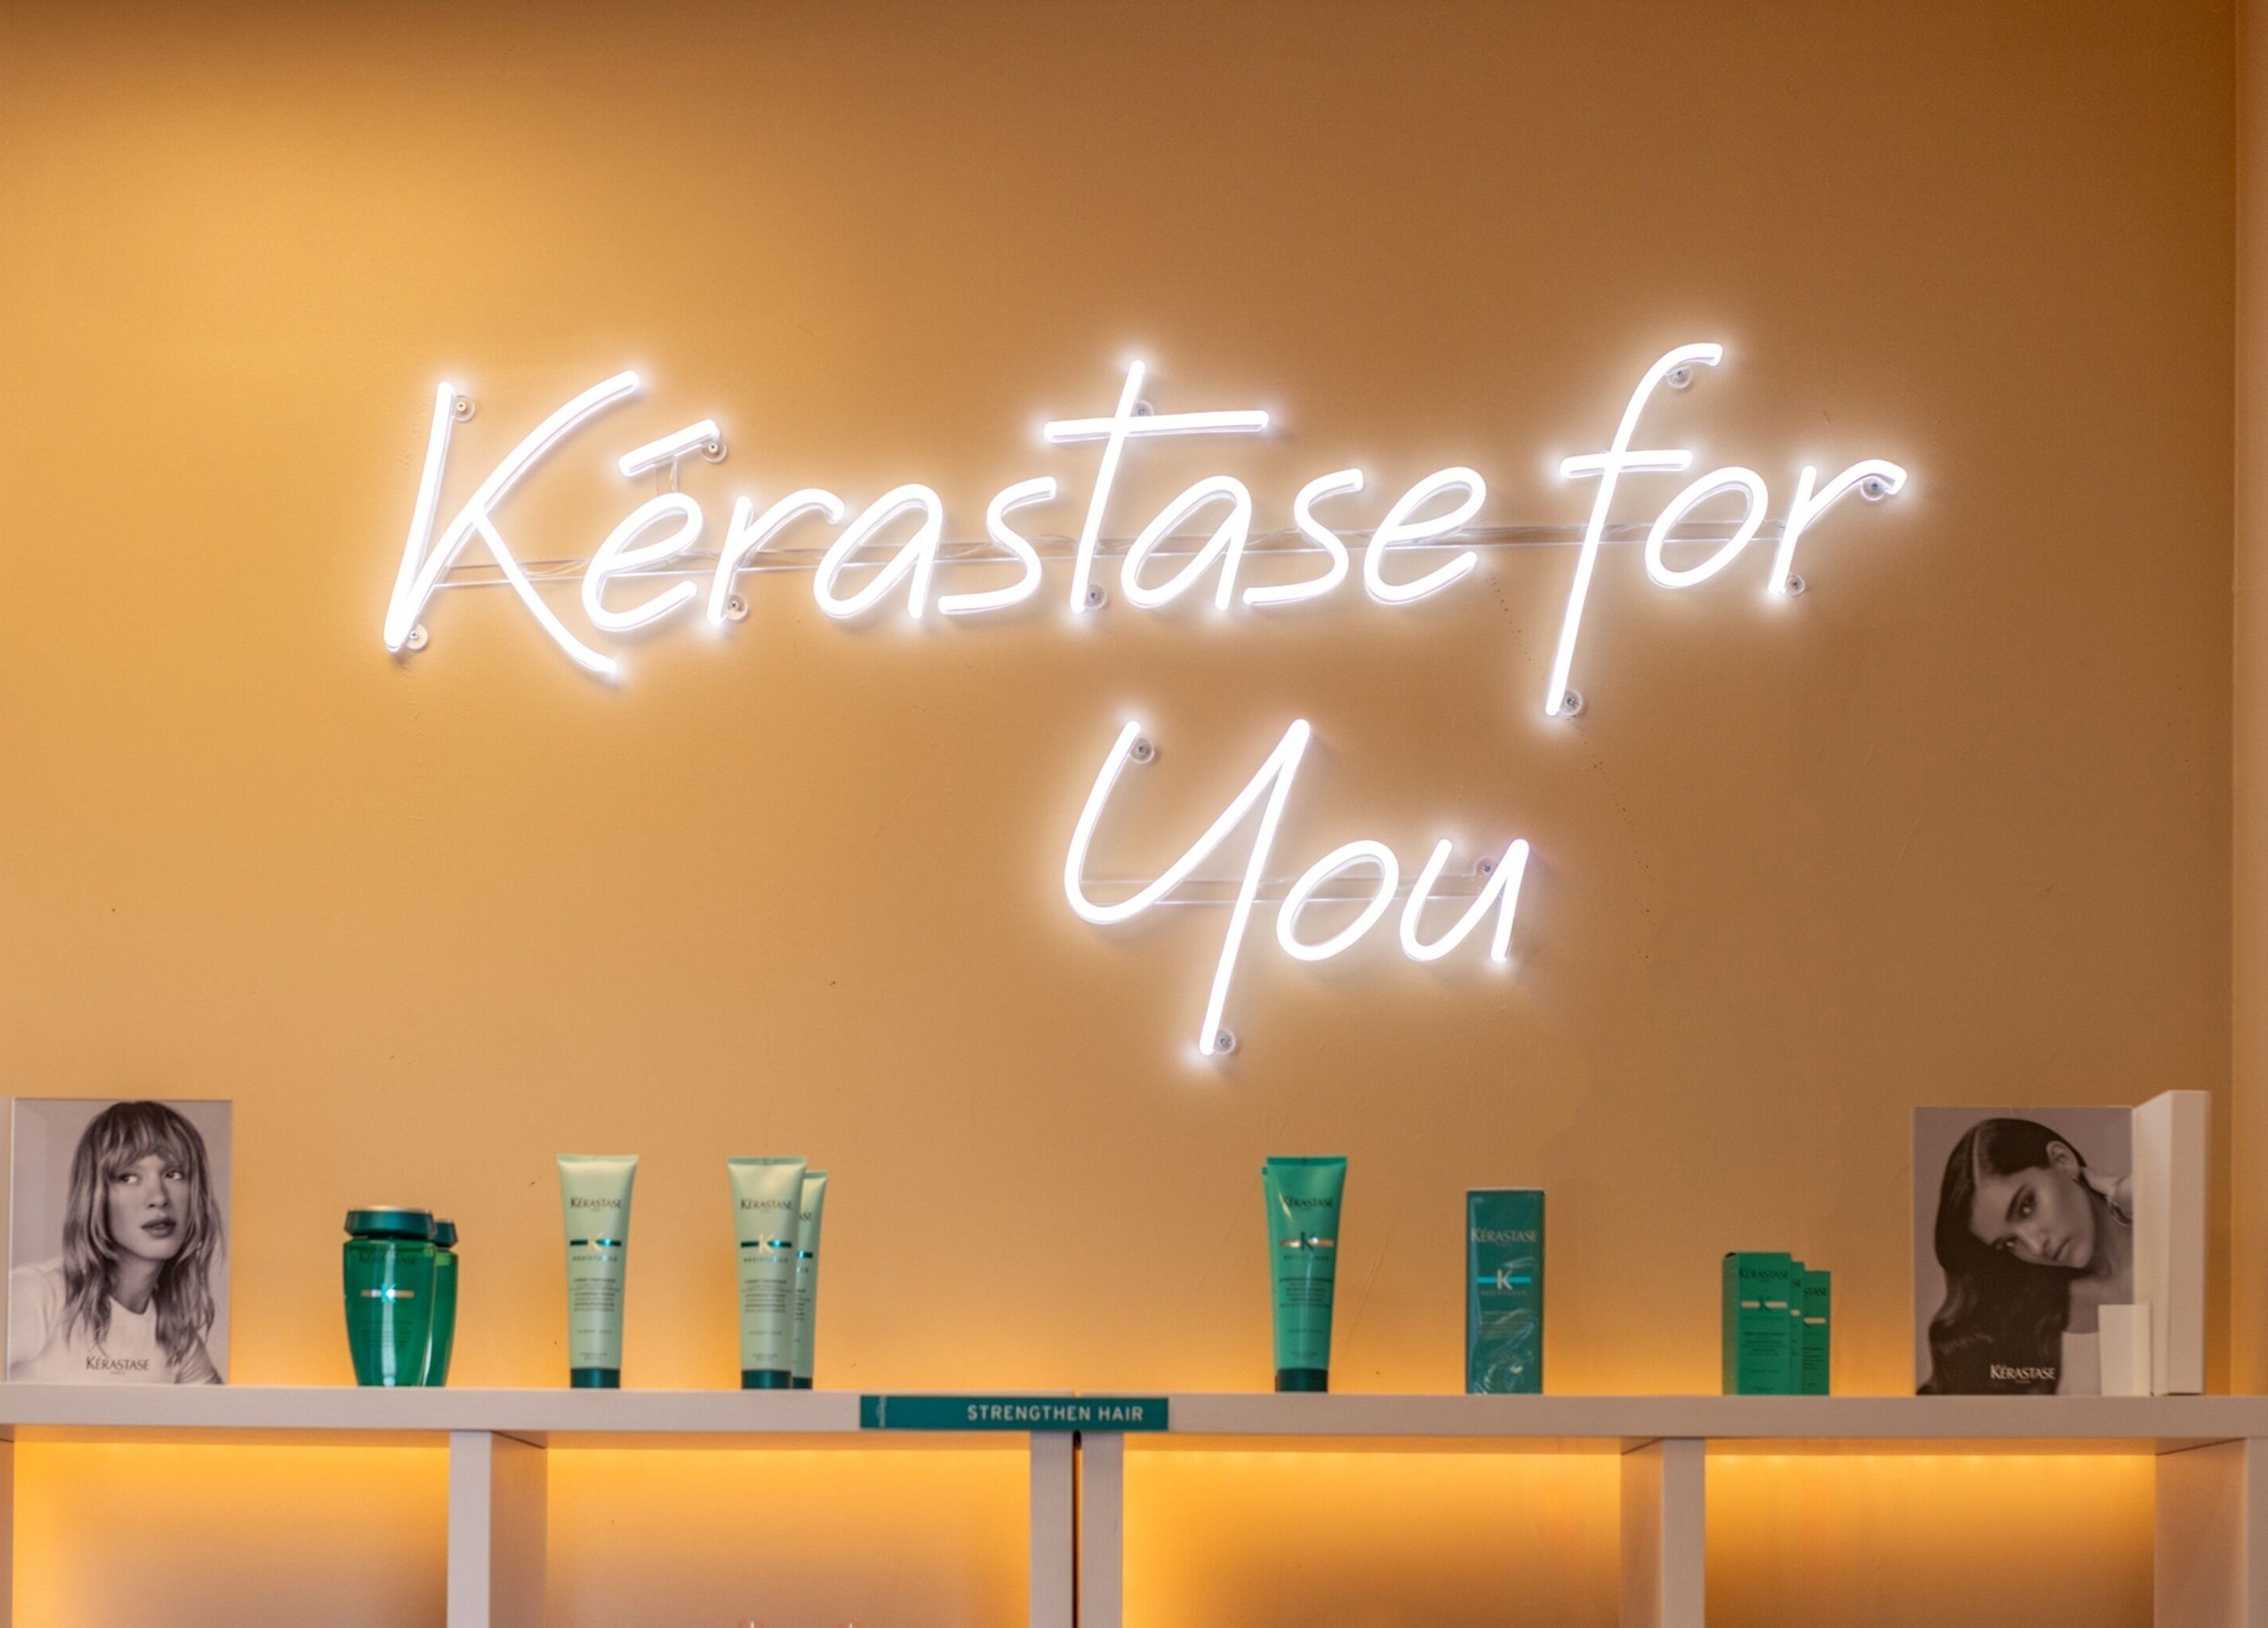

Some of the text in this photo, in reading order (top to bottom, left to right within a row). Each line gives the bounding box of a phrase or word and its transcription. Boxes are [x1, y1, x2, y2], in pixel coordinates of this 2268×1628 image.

[383, 343, 1907, 716] Kérastase for
[1064, 719, 1529, 1055] You
[1497, 1269, 1512, 1289] K
[86, 1355, 150, 1370] KÉRASTASE
[1990, 1364, 2056, 1379] KÉRASTASE
[967, 1404, 1143, 1421] STRENGTHEN HAIR
